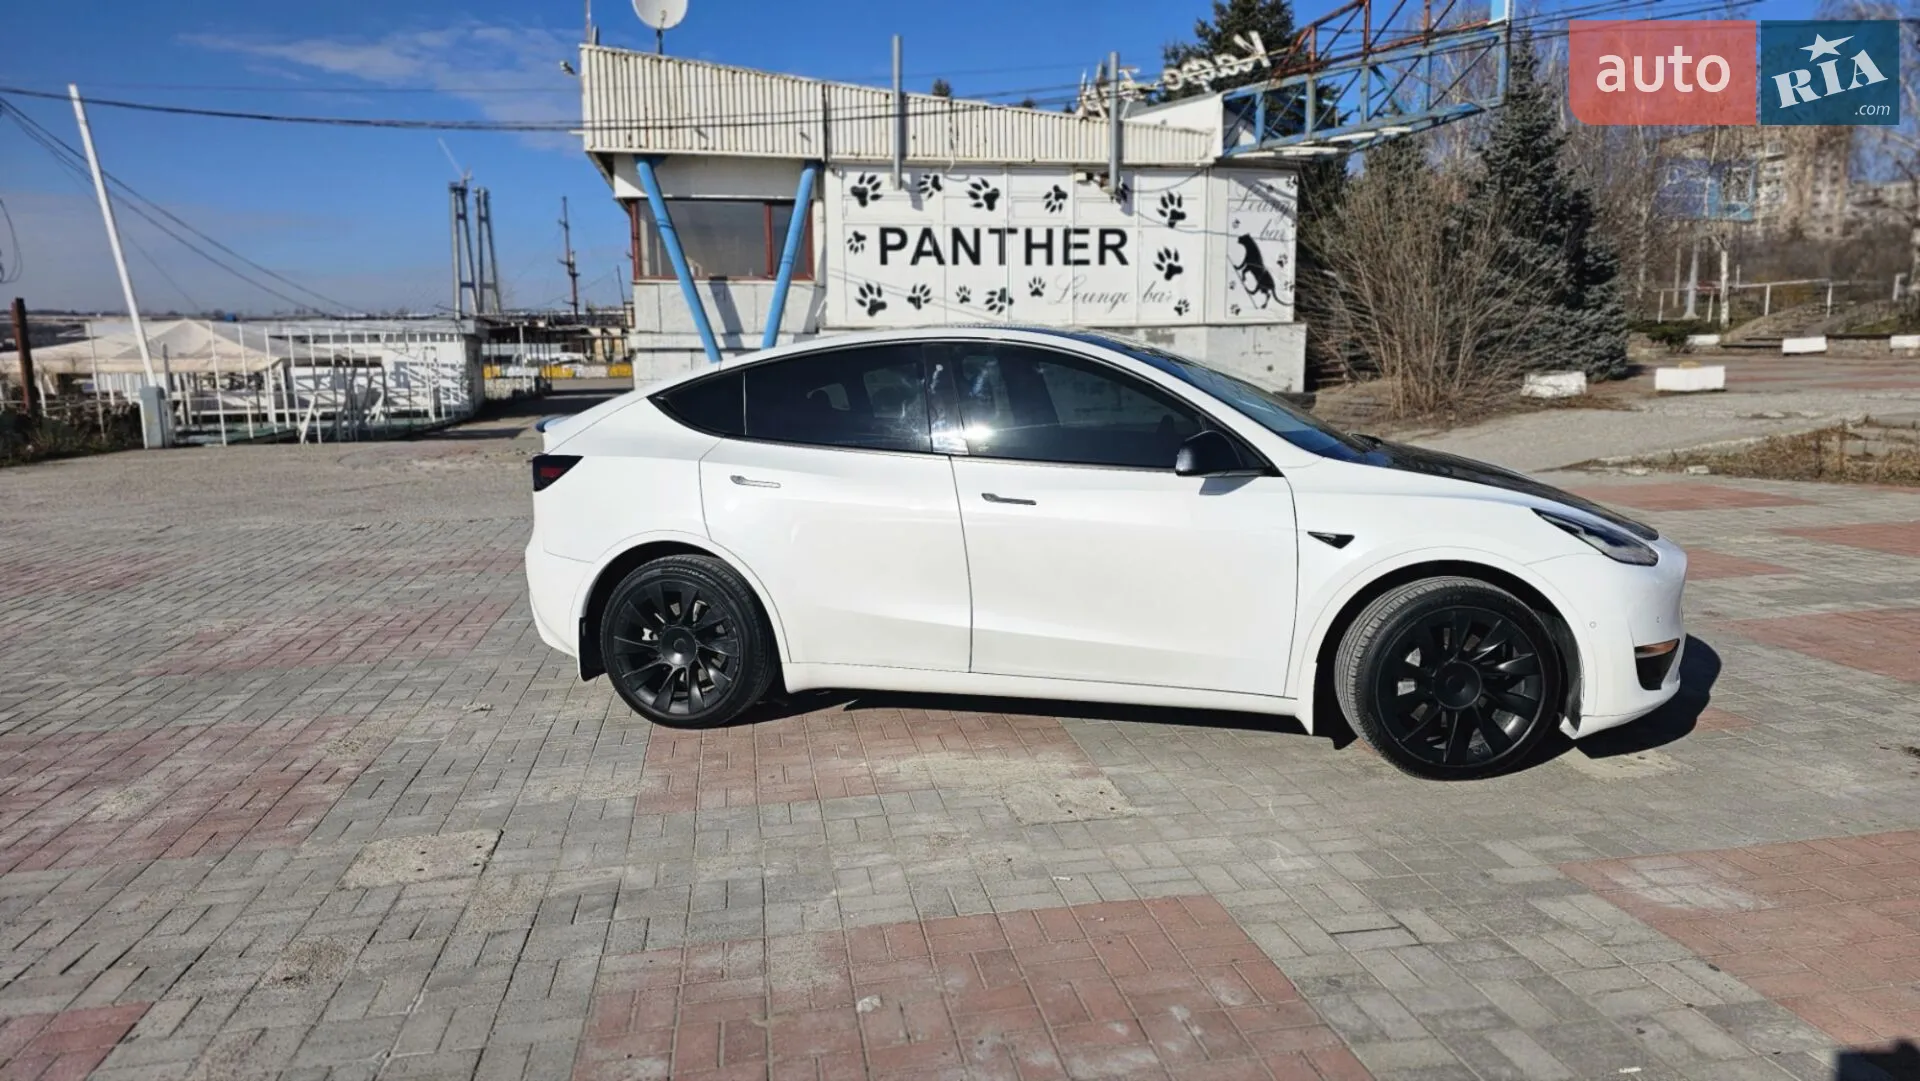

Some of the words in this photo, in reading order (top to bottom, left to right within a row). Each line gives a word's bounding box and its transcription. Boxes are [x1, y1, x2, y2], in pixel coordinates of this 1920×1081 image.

[878, 226, 1129, 267] PANTHER
[1047, 274, 1131, 314] Lounge
[1142, 280, 1173, 304] bar
